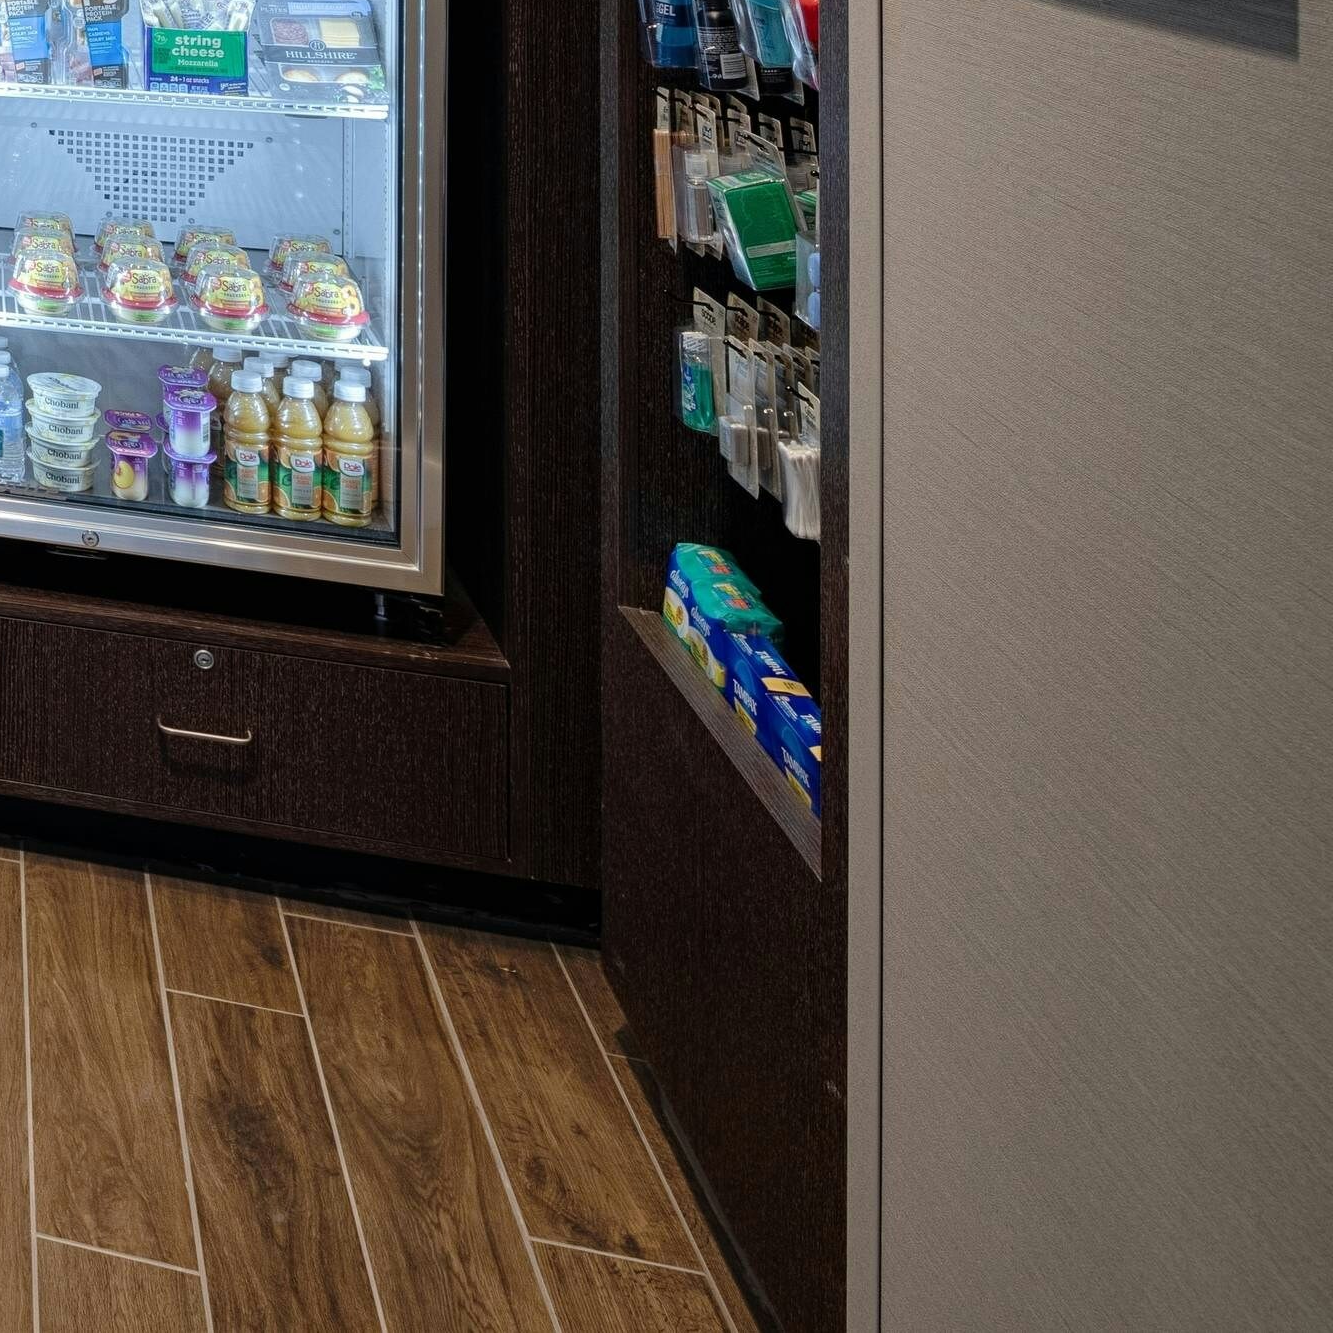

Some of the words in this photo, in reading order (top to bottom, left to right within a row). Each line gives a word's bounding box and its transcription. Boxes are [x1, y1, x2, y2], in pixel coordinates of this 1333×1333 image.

[174, 35, 222, 48] string
[171, 46, 225, 58] cheese
[285, 50, 356, 60] HILLSHIRE
[177, 59, 219, 67] Mozzarella
[33, 239, 56, 250] Sabra
[120, 245, 143, 258] Sabra
[206, 254, 231, 267] Sabra
[36, 262, 61, 274] Sabra
[132, 272, 157, 285] Sabra
[222, 280, 247, 293] Sabra
[314, 286, 339, 299] Sabra
[45, 397, 79, 410] Chobani
[48, 423, 83, 436] Chobani
[47, 448, 82, 460] Chobani
[239, 452, 257, 461] Dole
[294, 459, 312, 469] Dole
[343, 462, 361, 472] Dole
[45, 471, 80, 484] Chobani
[669, 569, 690, 599] always
[690, 606, 712, 637] always
[733, 678, 758, 716] TAMPAX
[781, 746, 811, 788] TAMPAX
